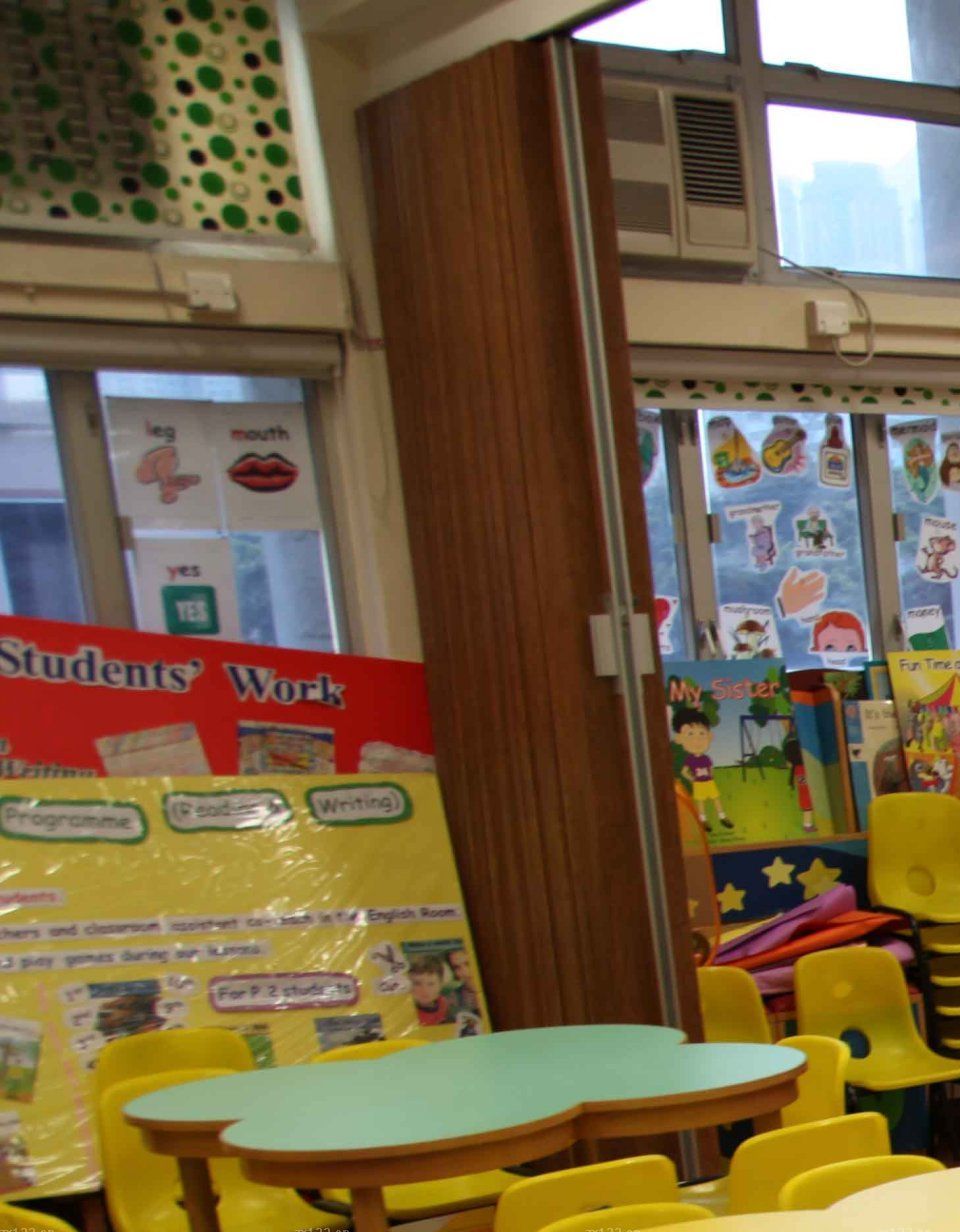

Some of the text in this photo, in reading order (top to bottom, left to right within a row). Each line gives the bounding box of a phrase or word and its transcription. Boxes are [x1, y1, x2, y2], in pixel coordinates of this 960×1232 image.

[146, 420, 177, 443] leg
[230, 425, 291, 443] mouth
[166, 564, 200, 581] yes
[175, 600, 208, 623] YES
[900, 657, 920, 672] Fun
[925, 657, 952, 671] Time
[228, 664, 344, 706] Work
[669, 677, 781, 709] My Sister
[319, 791, 400, 815] Writing)
[6, 806, 132, 832] Programme
[367, 906, 416, 923] English
[219, 988, 245, 1001] For
